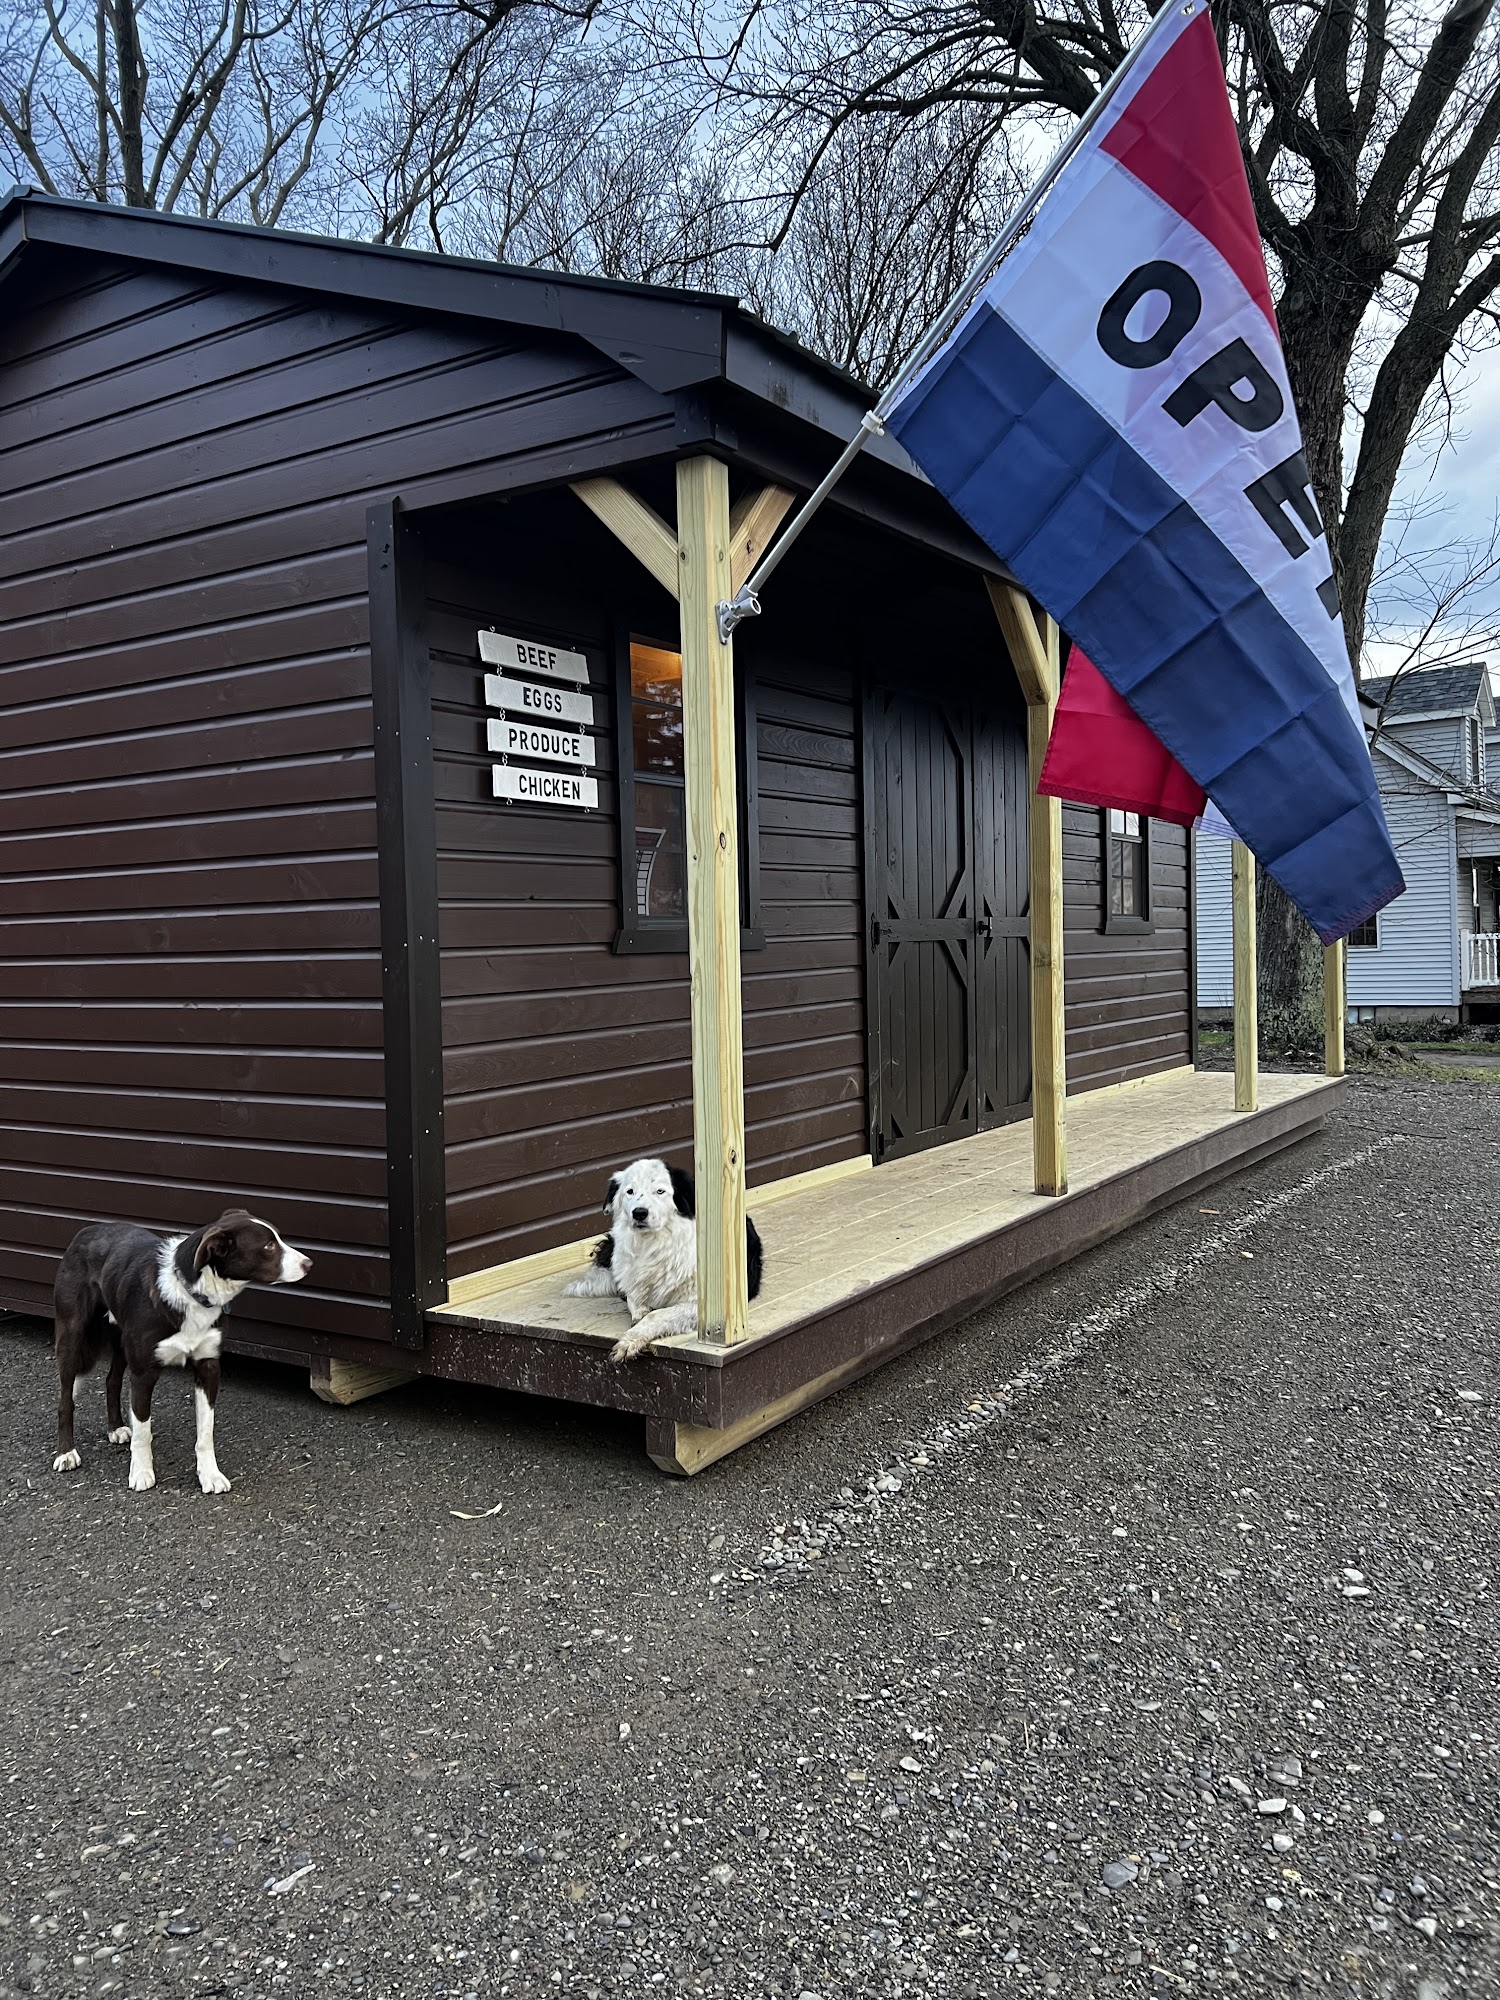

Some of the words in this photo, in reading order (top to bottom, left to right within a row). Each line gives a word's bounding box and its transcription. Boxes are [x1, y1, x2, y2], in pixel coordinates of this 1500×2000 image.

[1097, 260, 1341, 620] OPE
[516, 643, 557, 670] BEEF
[523, 686, 562, 713] EGGS
[508, 728, 580, 757] PRODUCE
[519, 774, 580, 800] CHICKEN
